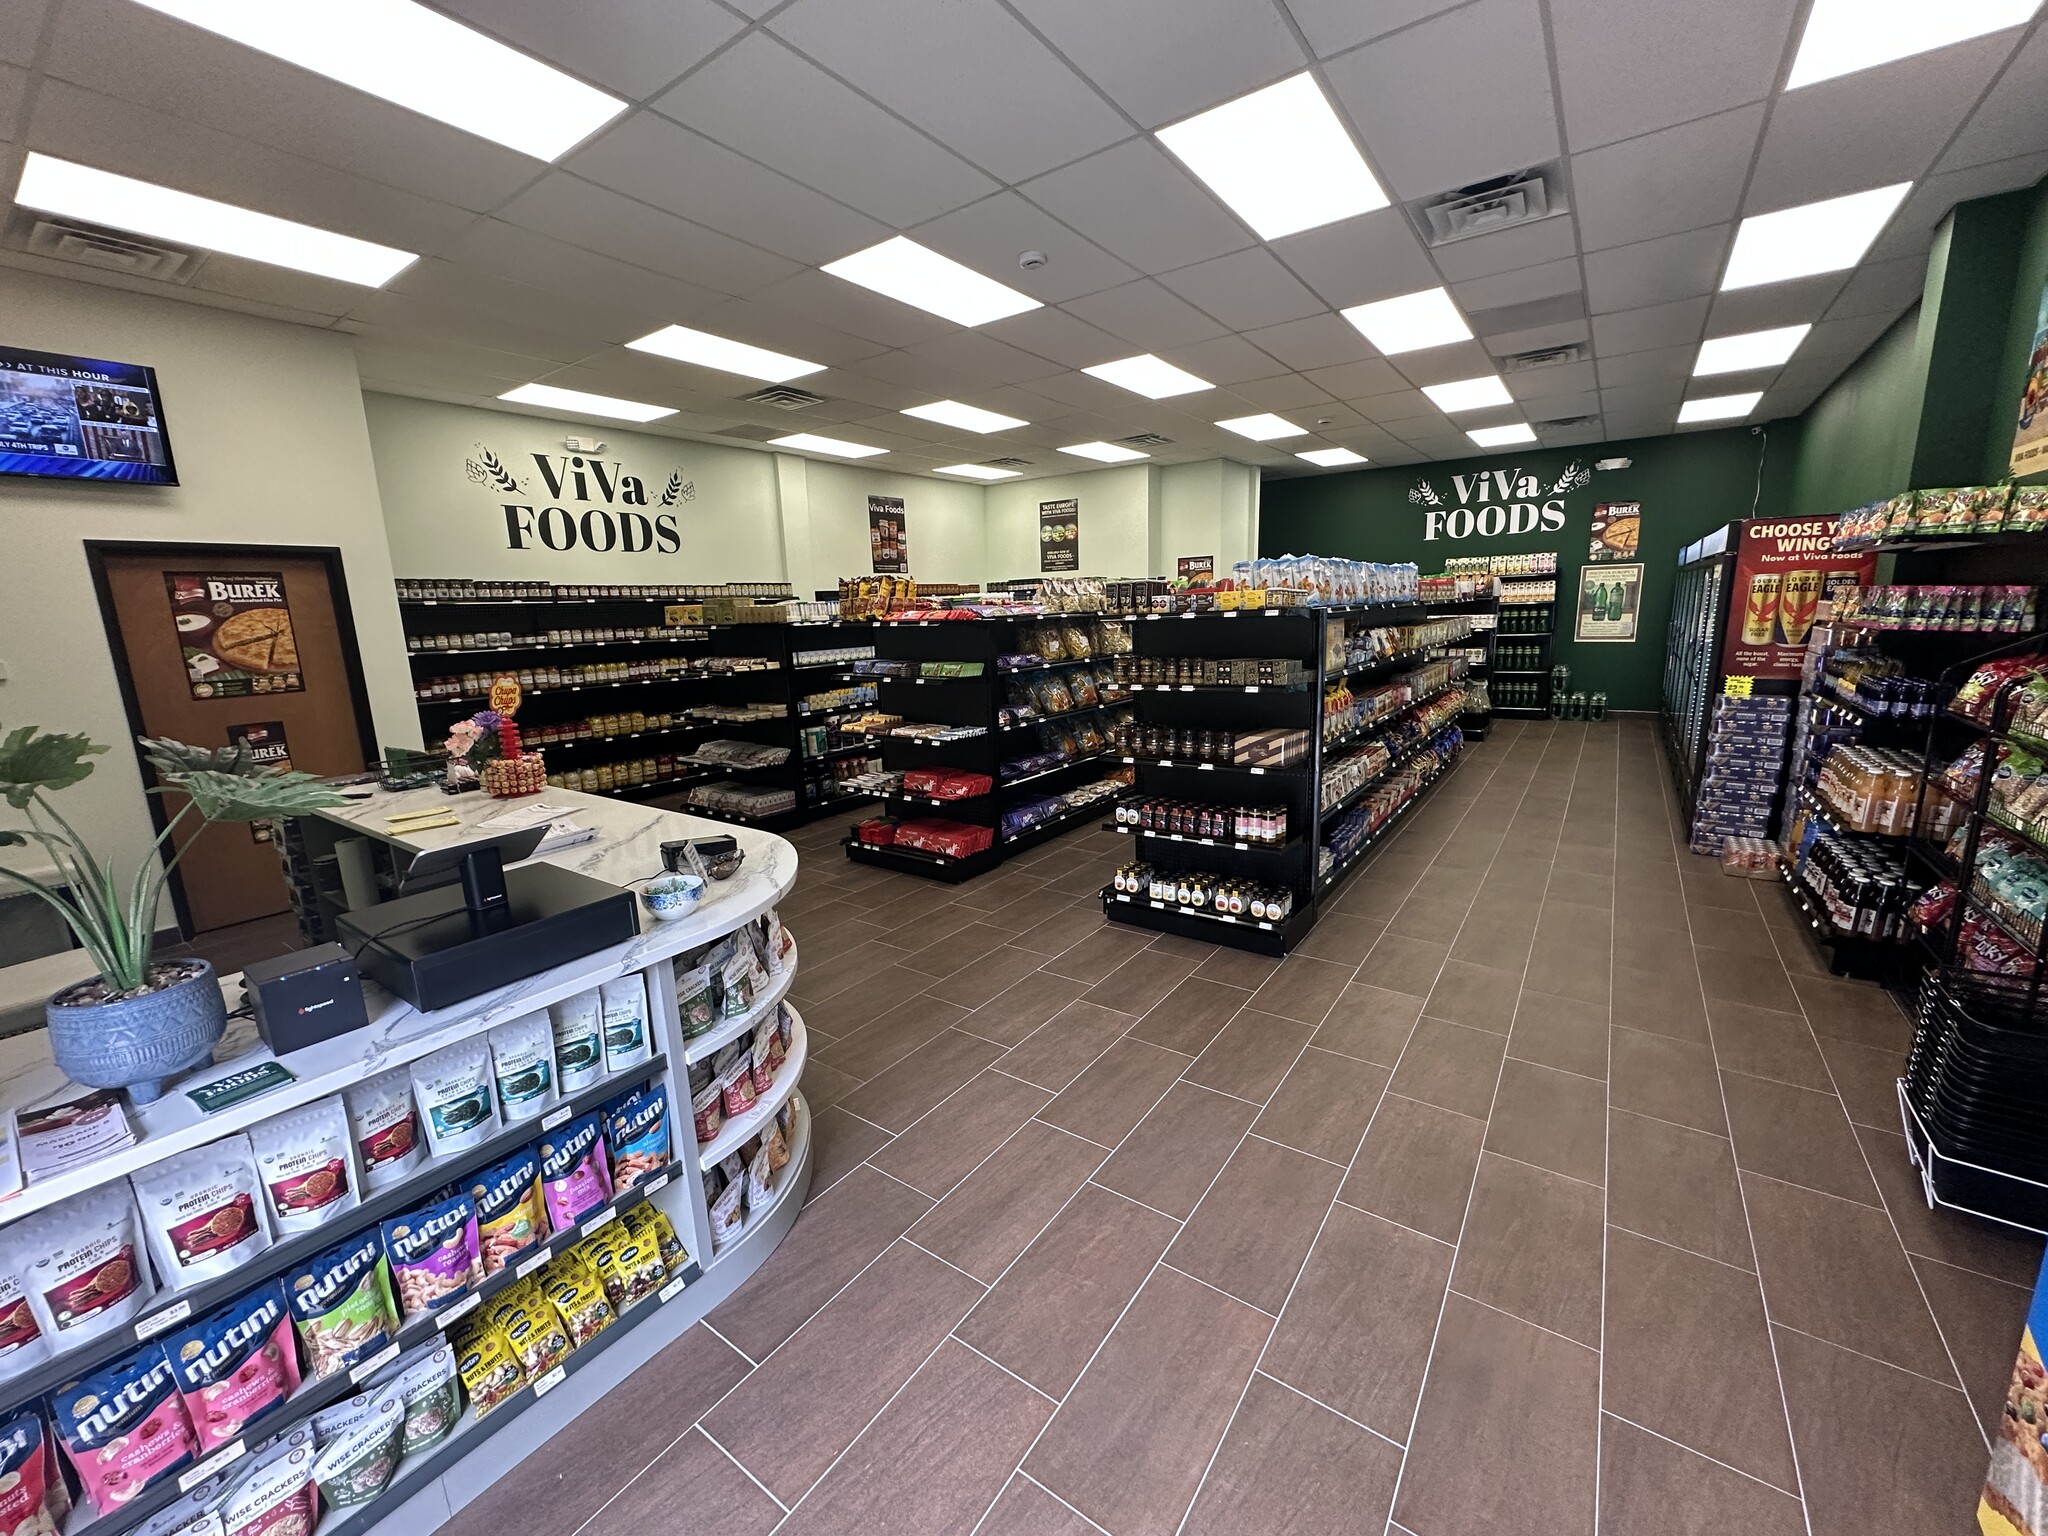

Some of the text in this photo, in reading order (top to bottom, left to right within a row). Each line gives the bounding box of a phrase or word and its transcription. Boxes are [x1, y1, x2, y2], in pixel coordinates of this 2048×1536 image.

[17, 363, 110, 382] AT THIS HOUR
[28, 443, 49, 451] TRIPS
[531, 453, 648, 506] ViVa
[1451, 468, 1541, 505] ViVa
[869, 503, 904, 514] Viva Foods
[1608, 505, 1640, 516] BUREK
[500, 504, 681, 554] FOODS
[1424, 500, 1565, 541] FOODS
[1749, 522, 1822, 538] CHOOSE
[1189, 561, 1211, 570] BUREK
[1761, 554, 1785, 562] Now
[1803, 552, 1828, 560] Viva
[207, 581, 281, 601] BUREK
[1752, 584, 1779, 593] EAGLE
[1786, 583, 1818, 592] EAGLE
[494, 695, 516, 708] Chups
[495, 686, 517, 697] Chupa
[251, 744, 287, 760] UREK
[555, 1024, 588, 1038] PROTEIN CHIPS
[501, 1052, 536, 1067] PROTEIN CHIPS
[438, 1077, 476, 1096] PROTEIN CHIPS
[368, 1111, 390, 1126] PROTEIN
[391, 1103, 405, 1114] CHIPS
[616, 1098, 663, 1144] nutini
[543, 1124, 595, 1176] nutini
[279, 1157, 307, 1171] PROTEIN
[308, 1150, 328, 1160] CHIPS
[190, 1185, 218, 1199] ORGANIC
[475, 1161, 534, 1218] nutini
[570, 1176, 594, 1195] passion
[577, 1186, 590, 1195] mix
[178, 1193, 210, 1212] PROTEIN
[211, 1183, 233, 1197] CHIPS
[394, 1203, 468, 1258] nutini
[58, 1250, 93, 1273] PROTEIN
[94, 1236, 118, 1252] CHIPS
[71, 1239, 102, 1257] ORGANIC
[620, 1247, 638, 1262] nutini
[603, 1265, 615, 1274] NUTS
[625, 1261, 636, 1270] NUTS
[640, 1250, 655, 1263] FRUITS
[296, 1242, 376, 1312] nutini
[321, 1285, 346, 1307] premium
[559, 1289, 577, 1303] nutini
[580, 1290, 595, 1303] FRUITS
[511, 1321, 530, 1339] nutini
[534, 1320, 552, 1336] FRUITS
[185, 1300, 279, 1383] nutini
[212, 1349, 242, 1378] premium
[461, 1354, 479, 1373] nutini
[466, 1368, 481, 1383] NUTS
[485, 1352, 503, 1368] FRUITS
[221, 1375, 265, 1404] cashews
[406, 1368, 447, 1398] CRACKERS
[76, 1358, 172, 1443] nutin
[121, 1430, 170, 1463] cashews
[121, 1427, 188, 1470] cranberrie
[327, 1452, 350, 1471] WISE
[352, 1418, 395, 1452] CRACKERS
[0, 1486, 27, 1508] nuts
[0, 1492, 29, 1517] sted
[225, 1505, 252, 1525] WISE
[254, 1469, 305, 1507] CRACKERS
